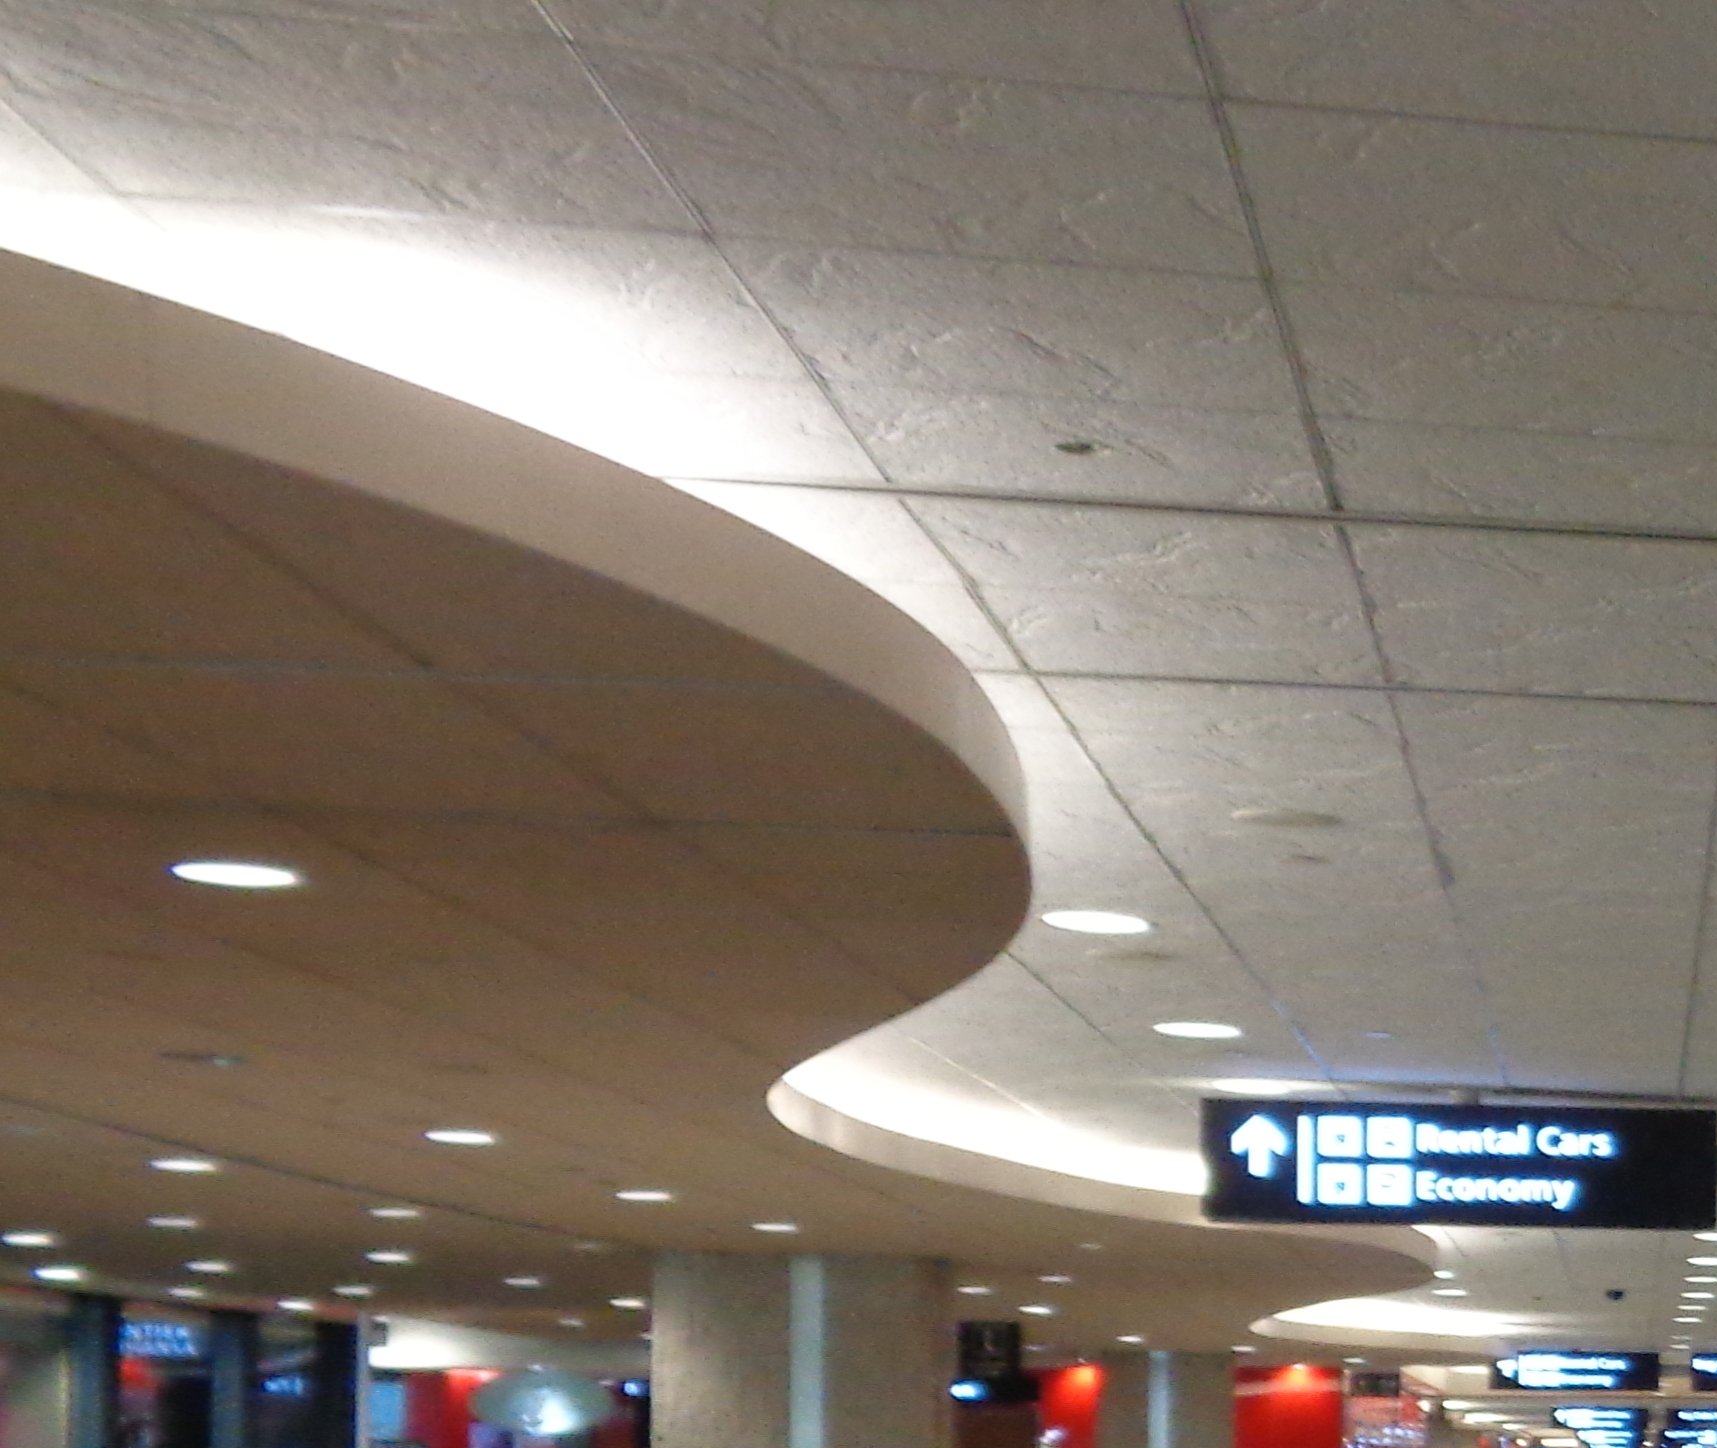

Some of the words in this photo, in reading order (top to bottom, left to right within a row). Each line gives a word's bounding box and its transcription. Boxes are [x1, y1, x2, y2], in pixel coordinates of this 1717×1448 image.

[1415, 1122, 1531, 1155] Rental
[1536, 1125, 1612, 1157] Cars
[1415, 1170, 1576, 1210] Economy
